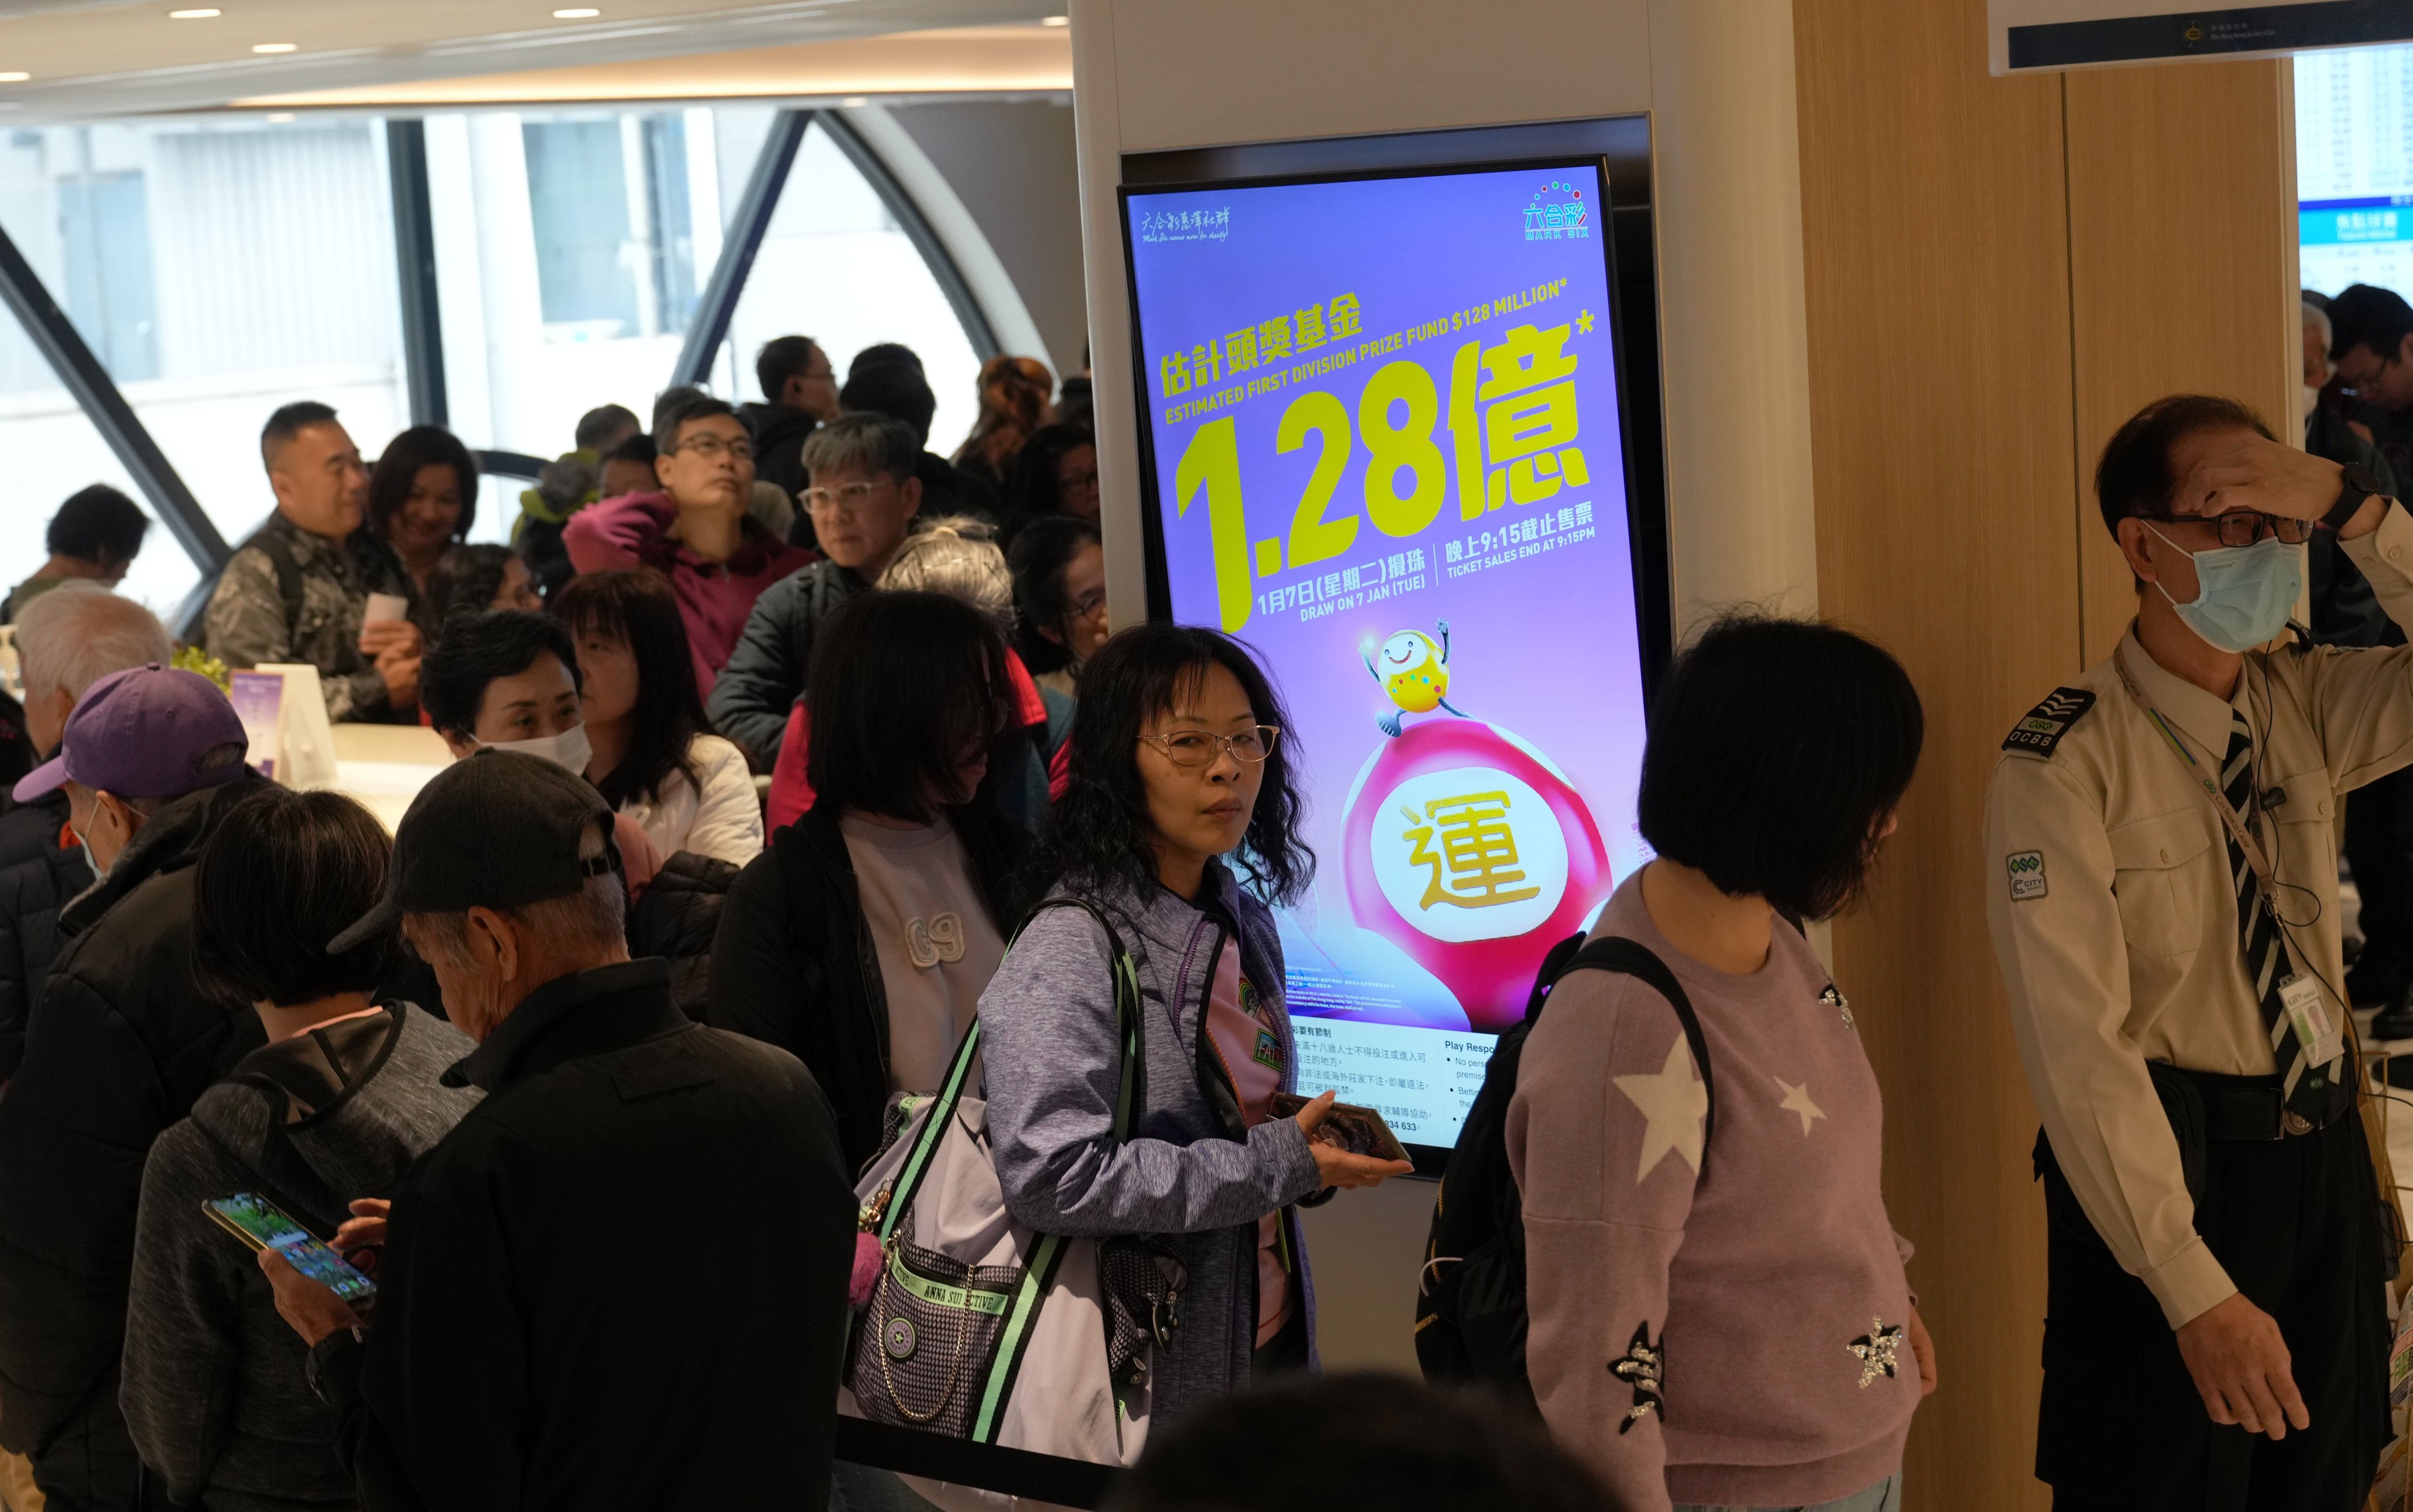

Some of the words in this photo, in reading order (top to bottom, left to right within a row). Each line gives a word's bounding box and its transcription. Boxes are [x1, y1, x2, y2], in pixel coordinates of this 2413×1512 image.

[1523, 202, 1586, 229] 六合彩
[1526, 230, 1562, 240] MARK
[1567, 228, 1589, 239] SIX
[1160, 292, 1362, 398] 估計頭獎基金
[1165, 386, 1244, 425] ESTIMATED
[1247, 369, 1288, 398] FIRST
[1292, 348, 1356, 384] DIVISION
[1359, 332, 1403, 361] PRIZE
[1407, 317, 1449, 346] FUND
[1452, 303, 1490, 332] $128
[1445, 500, 1593, 563] 晚上9:15截止售票
[1447, 559, 1483, 579] TICKET
[1484, 549, 1517, 569] SALES
[1519, 543, 1540, 559] END
[1543, 538, 1555, 552] AT
[1557, 526, 1596, 547] 9:15PM
[1258, 548, 1425, 615] 1月7日(星期二)攪珠
[1300, 600, 1335, 622] DRAW
[1338, 595, 1354, 611] ON
[1356, 592, 1364, 606] 7
[1366, 584, 1390, 603] JAN
[1392, 573, 1425, 597] (TUE)
[2009, 731, 2052, 746] OCBB
[1400, 790, 1541, 912] 運
[2025, 879, 2042, 887] CITY
[1445, 1041, 1464, 1052] Play
[925, 1285, 946, 1302] ANNA
[948, 1291, 963, 1305] SUI
[963, 1294, 993, 1310] CTIVE
